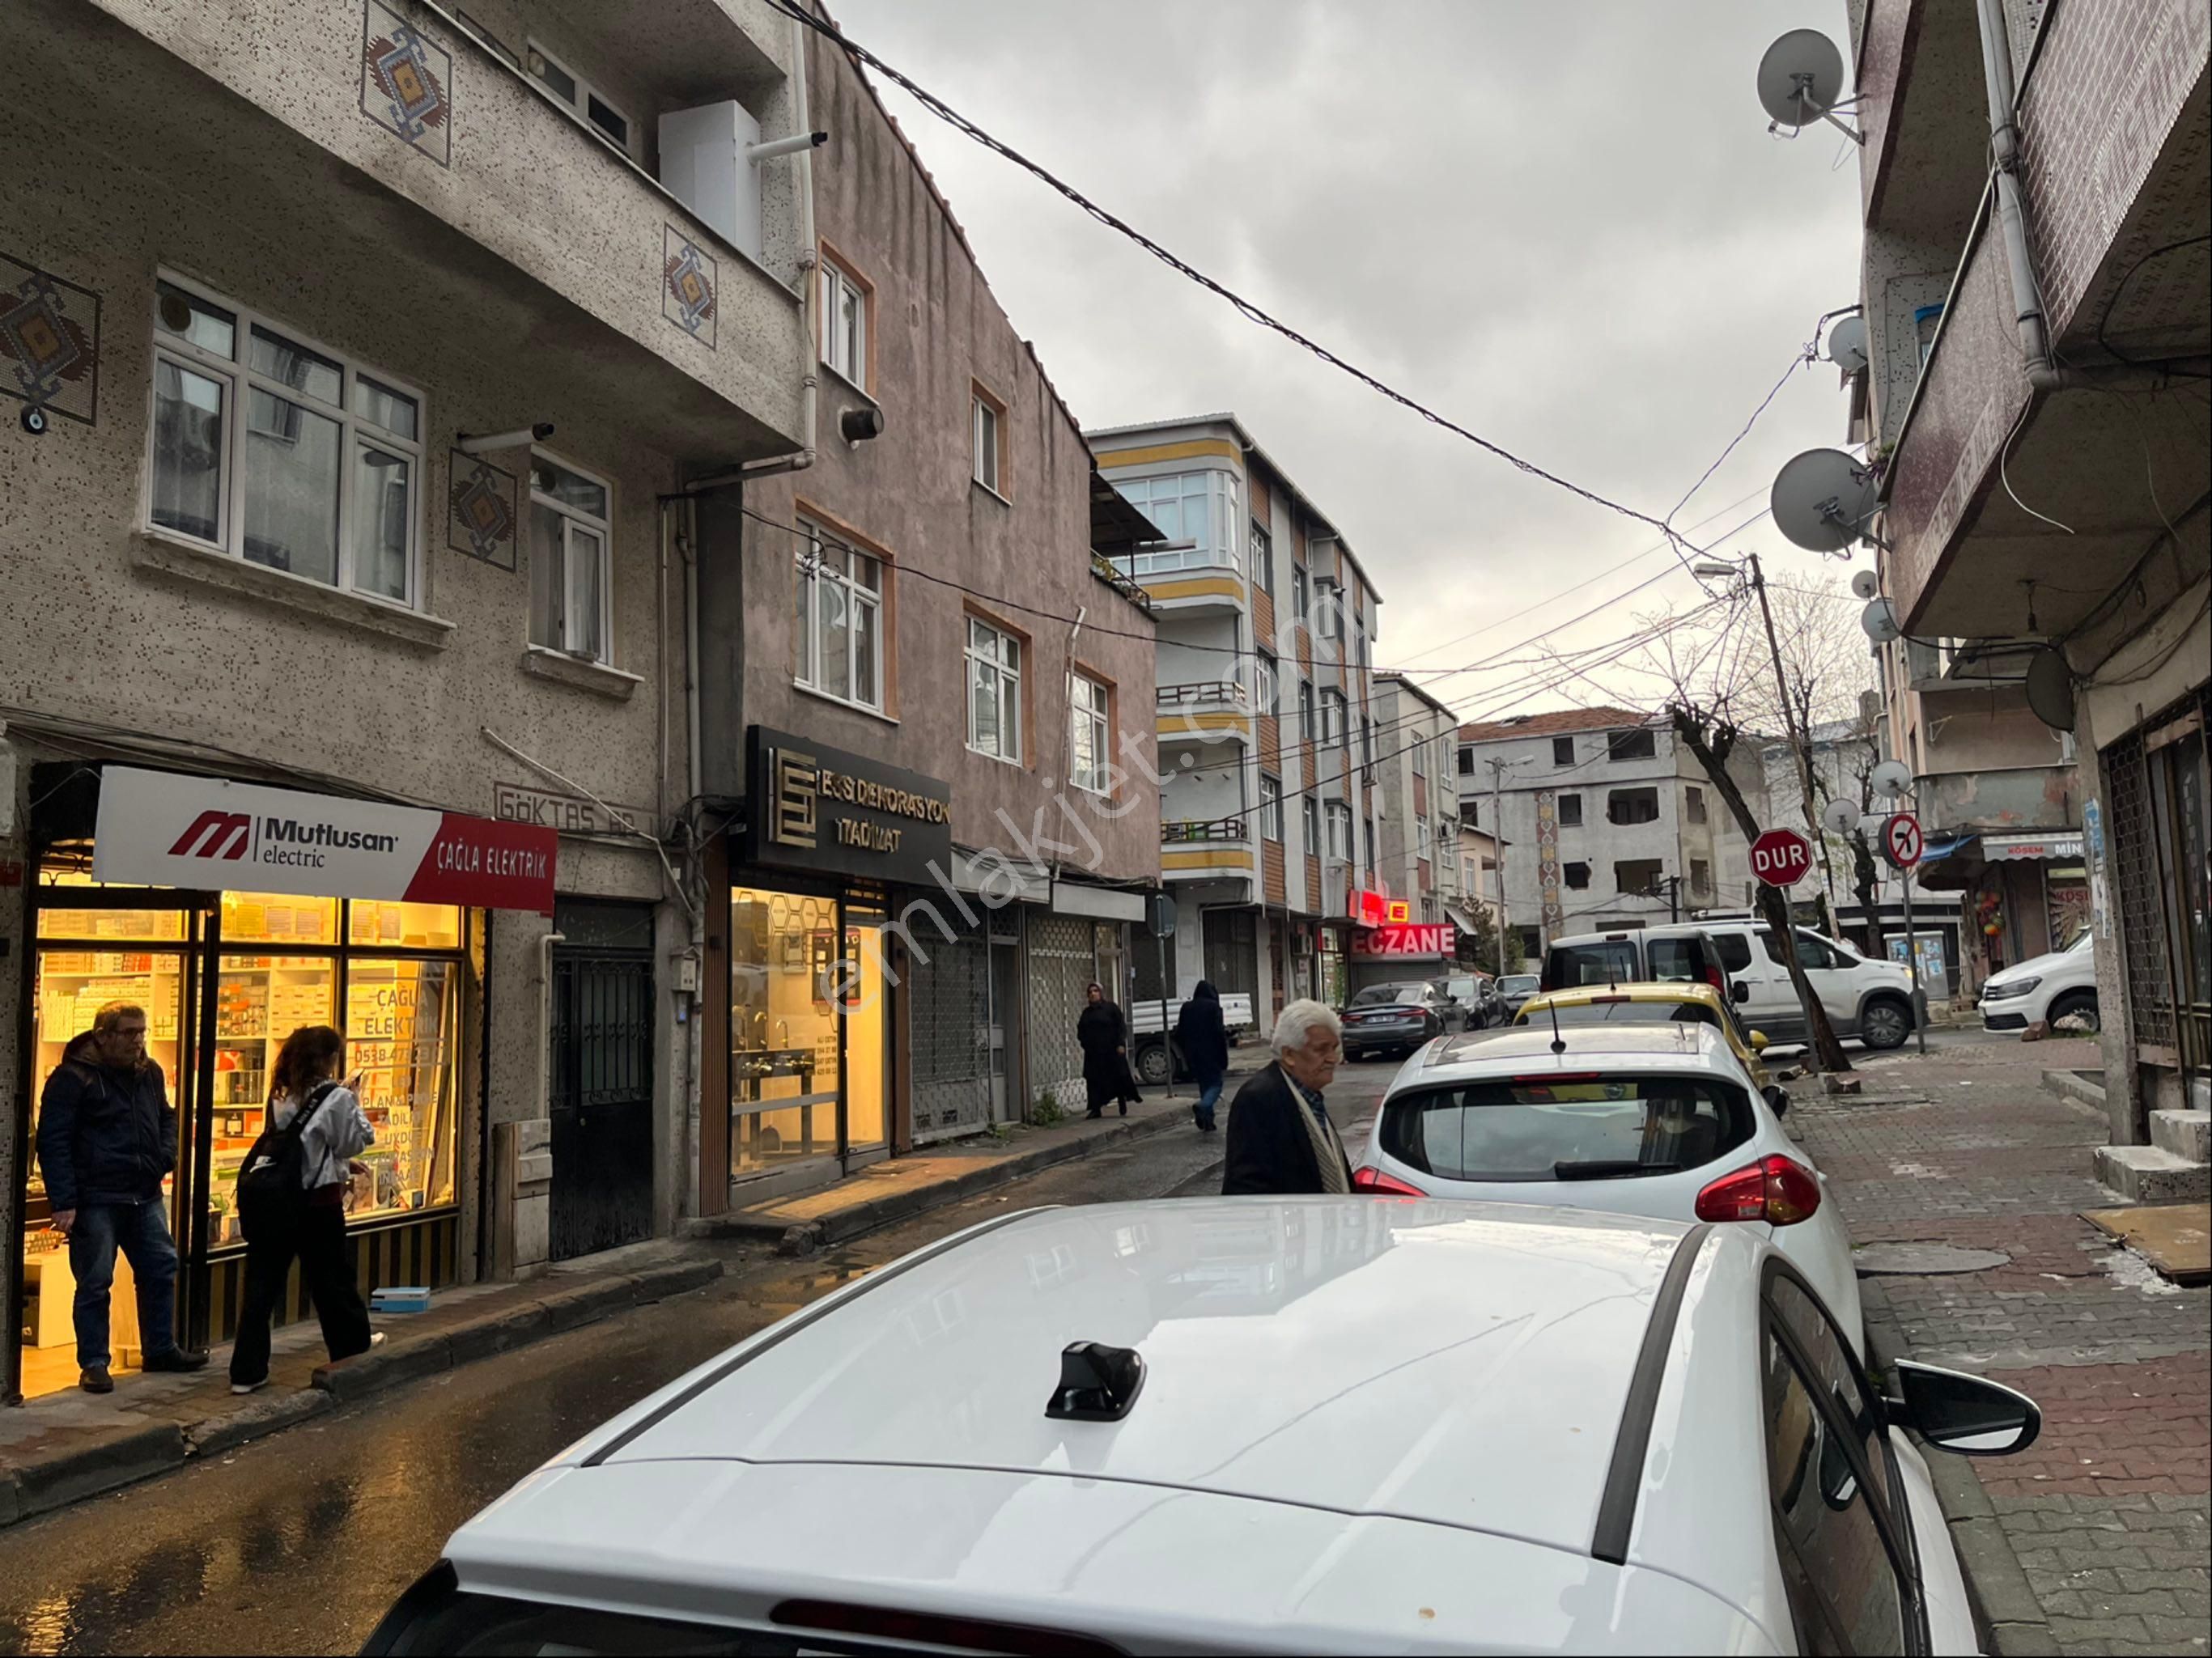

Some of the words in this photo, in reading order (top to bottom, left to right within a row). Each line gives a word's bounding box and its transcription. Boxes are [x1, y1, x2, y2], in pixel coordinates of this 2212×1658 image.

[265, 817, 394, 853] Mutlusan
[263, 846, 325, 868] electric
[437, 837, 480, 875] ÇAĞLA
[486, 848, 546, 879] ELEKTRİK
[1755, 844, 1806, 873] DUR
[1352, 927, 1455, 954] ECZANE
